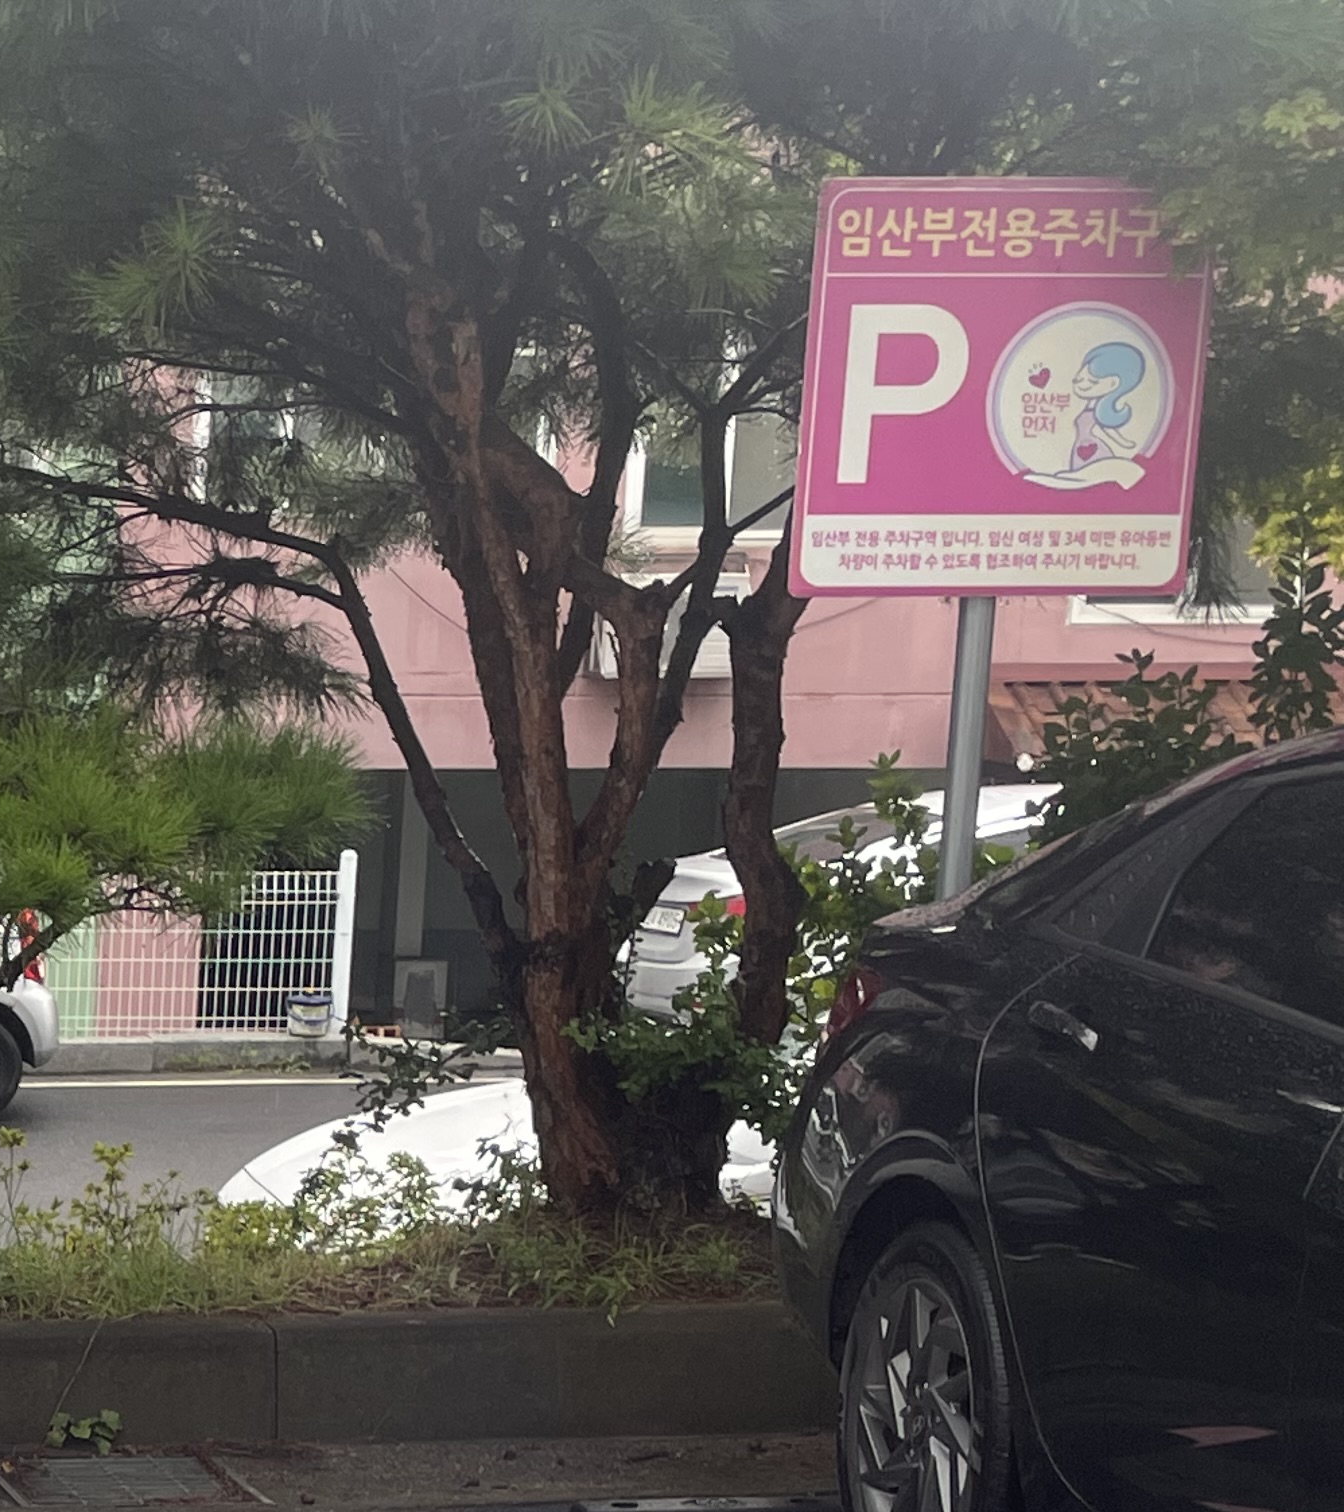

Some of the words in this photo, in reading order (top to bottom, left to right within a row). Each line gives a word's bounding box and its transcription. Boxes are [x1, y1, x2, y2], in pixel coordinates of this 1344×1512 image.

[837, 207, 1165, 258] 임산부전용주차구
[836, 304, 969, 484] P
[1021, 392, 1070, 414] 임산부
[1021, 416, 1056, 438] 먼저
[811, 531, 850, 548] 임산부
[854, 531, 879, 547] 전용
[884, 531, 937, 547] 주차구역
